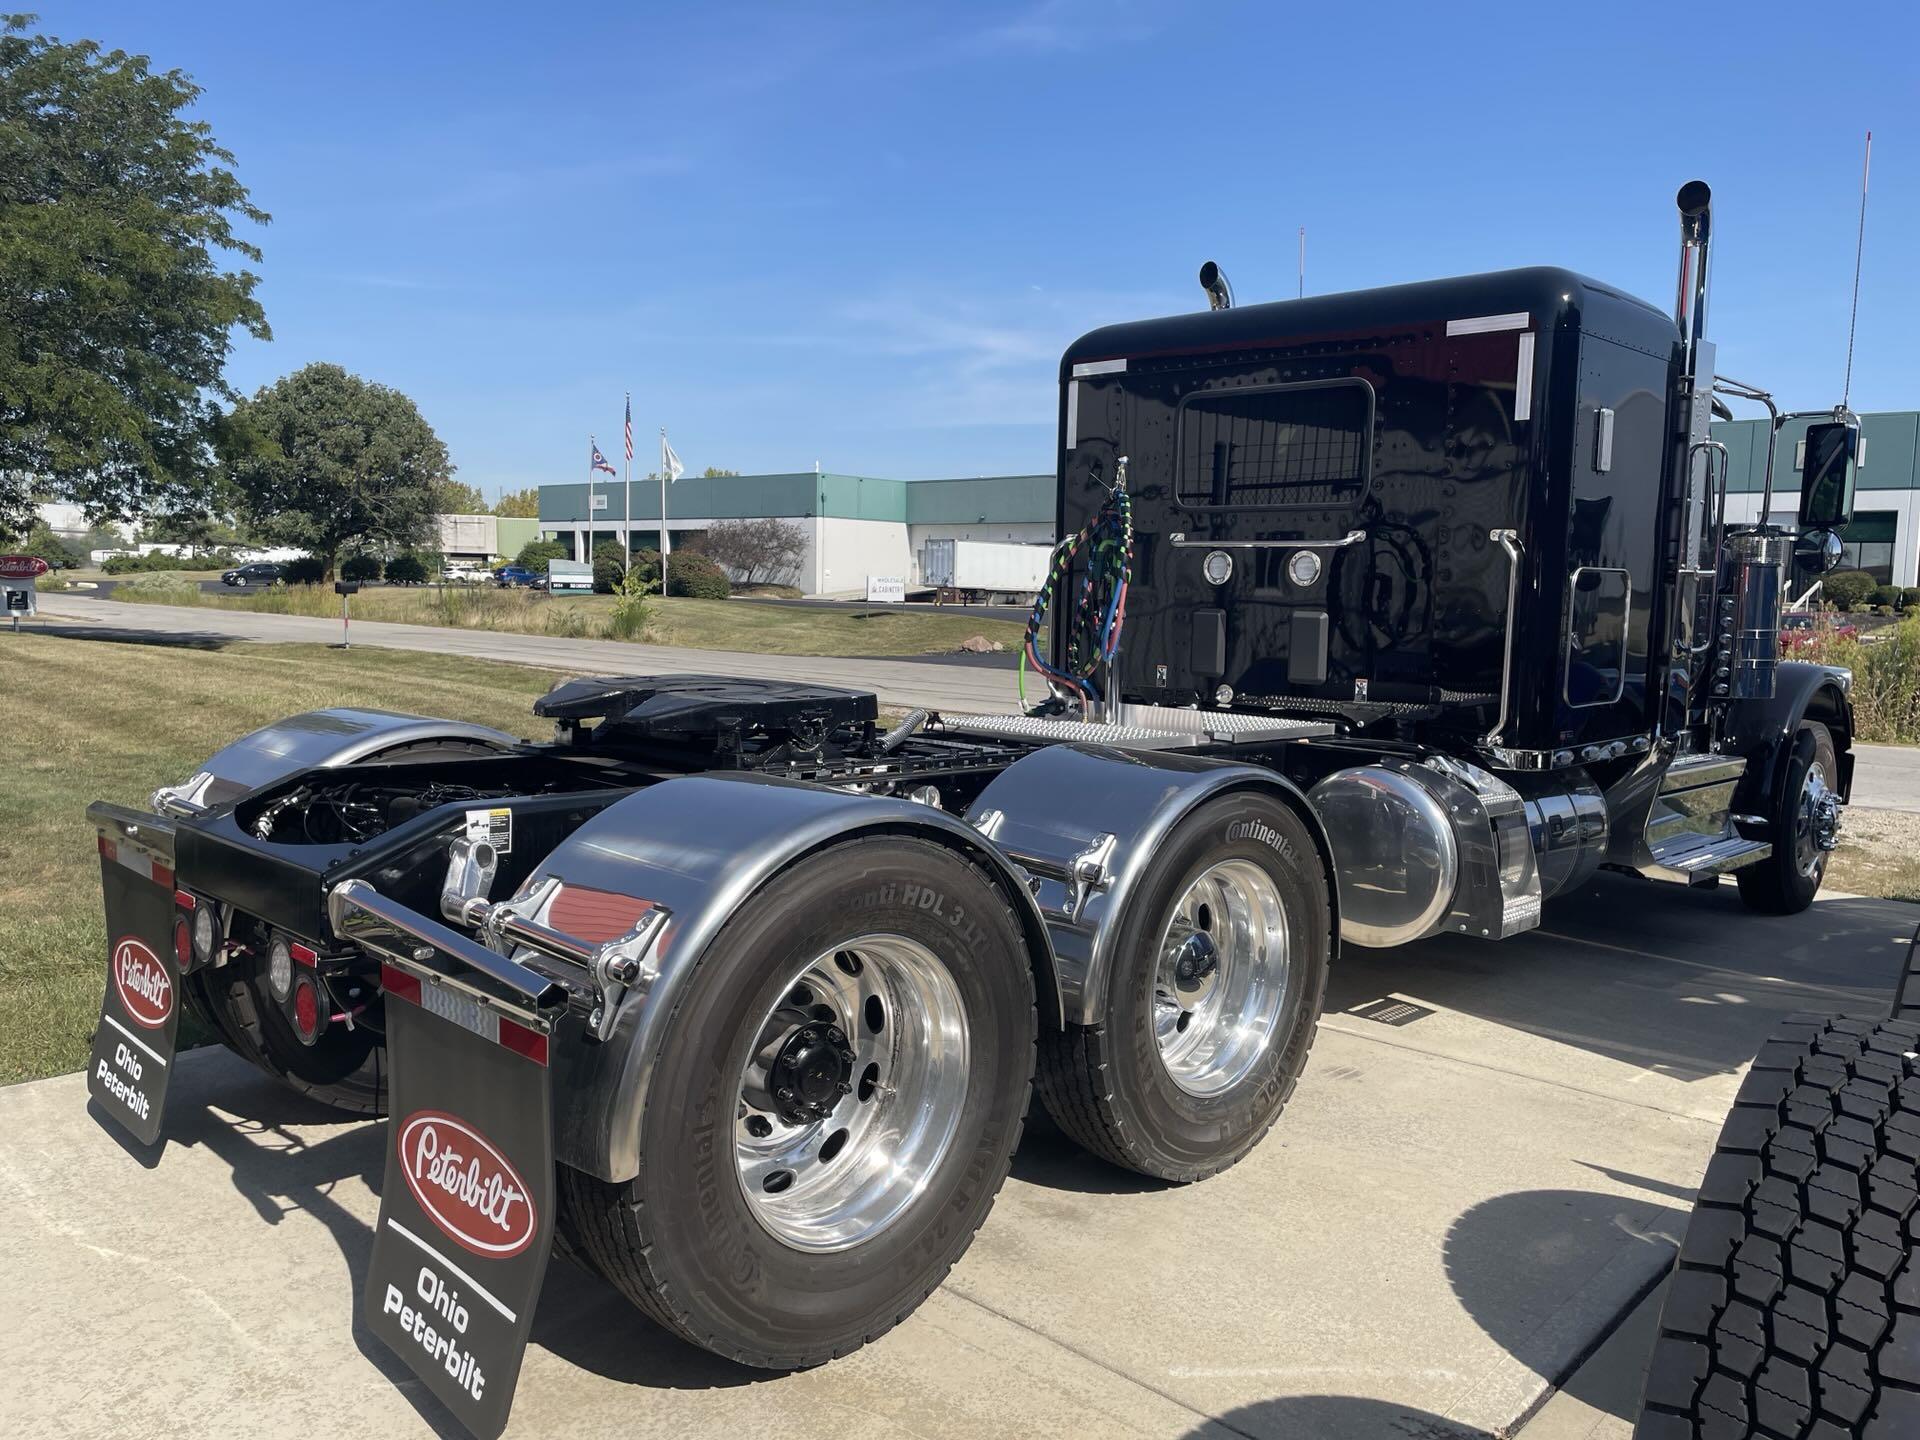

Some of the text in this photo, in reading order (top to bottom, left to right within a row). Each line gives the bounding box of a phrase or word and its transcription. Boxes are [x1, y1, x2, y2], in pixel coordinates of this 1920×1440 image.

[902, 885, 945, 917] HDL
[949, 906, 965, 927] 3
[121, 946, 170, 1011] Peterbilt
[96, 1058, 150, 1121] Peterbilt
[115, 1042, 143, 1081] Ohio
[416, 1125, 524, 1232] Peterbilt
[417, 1266, 469, 1334] Ohio
[383, 1283, 486, 1401] Peterbilt
